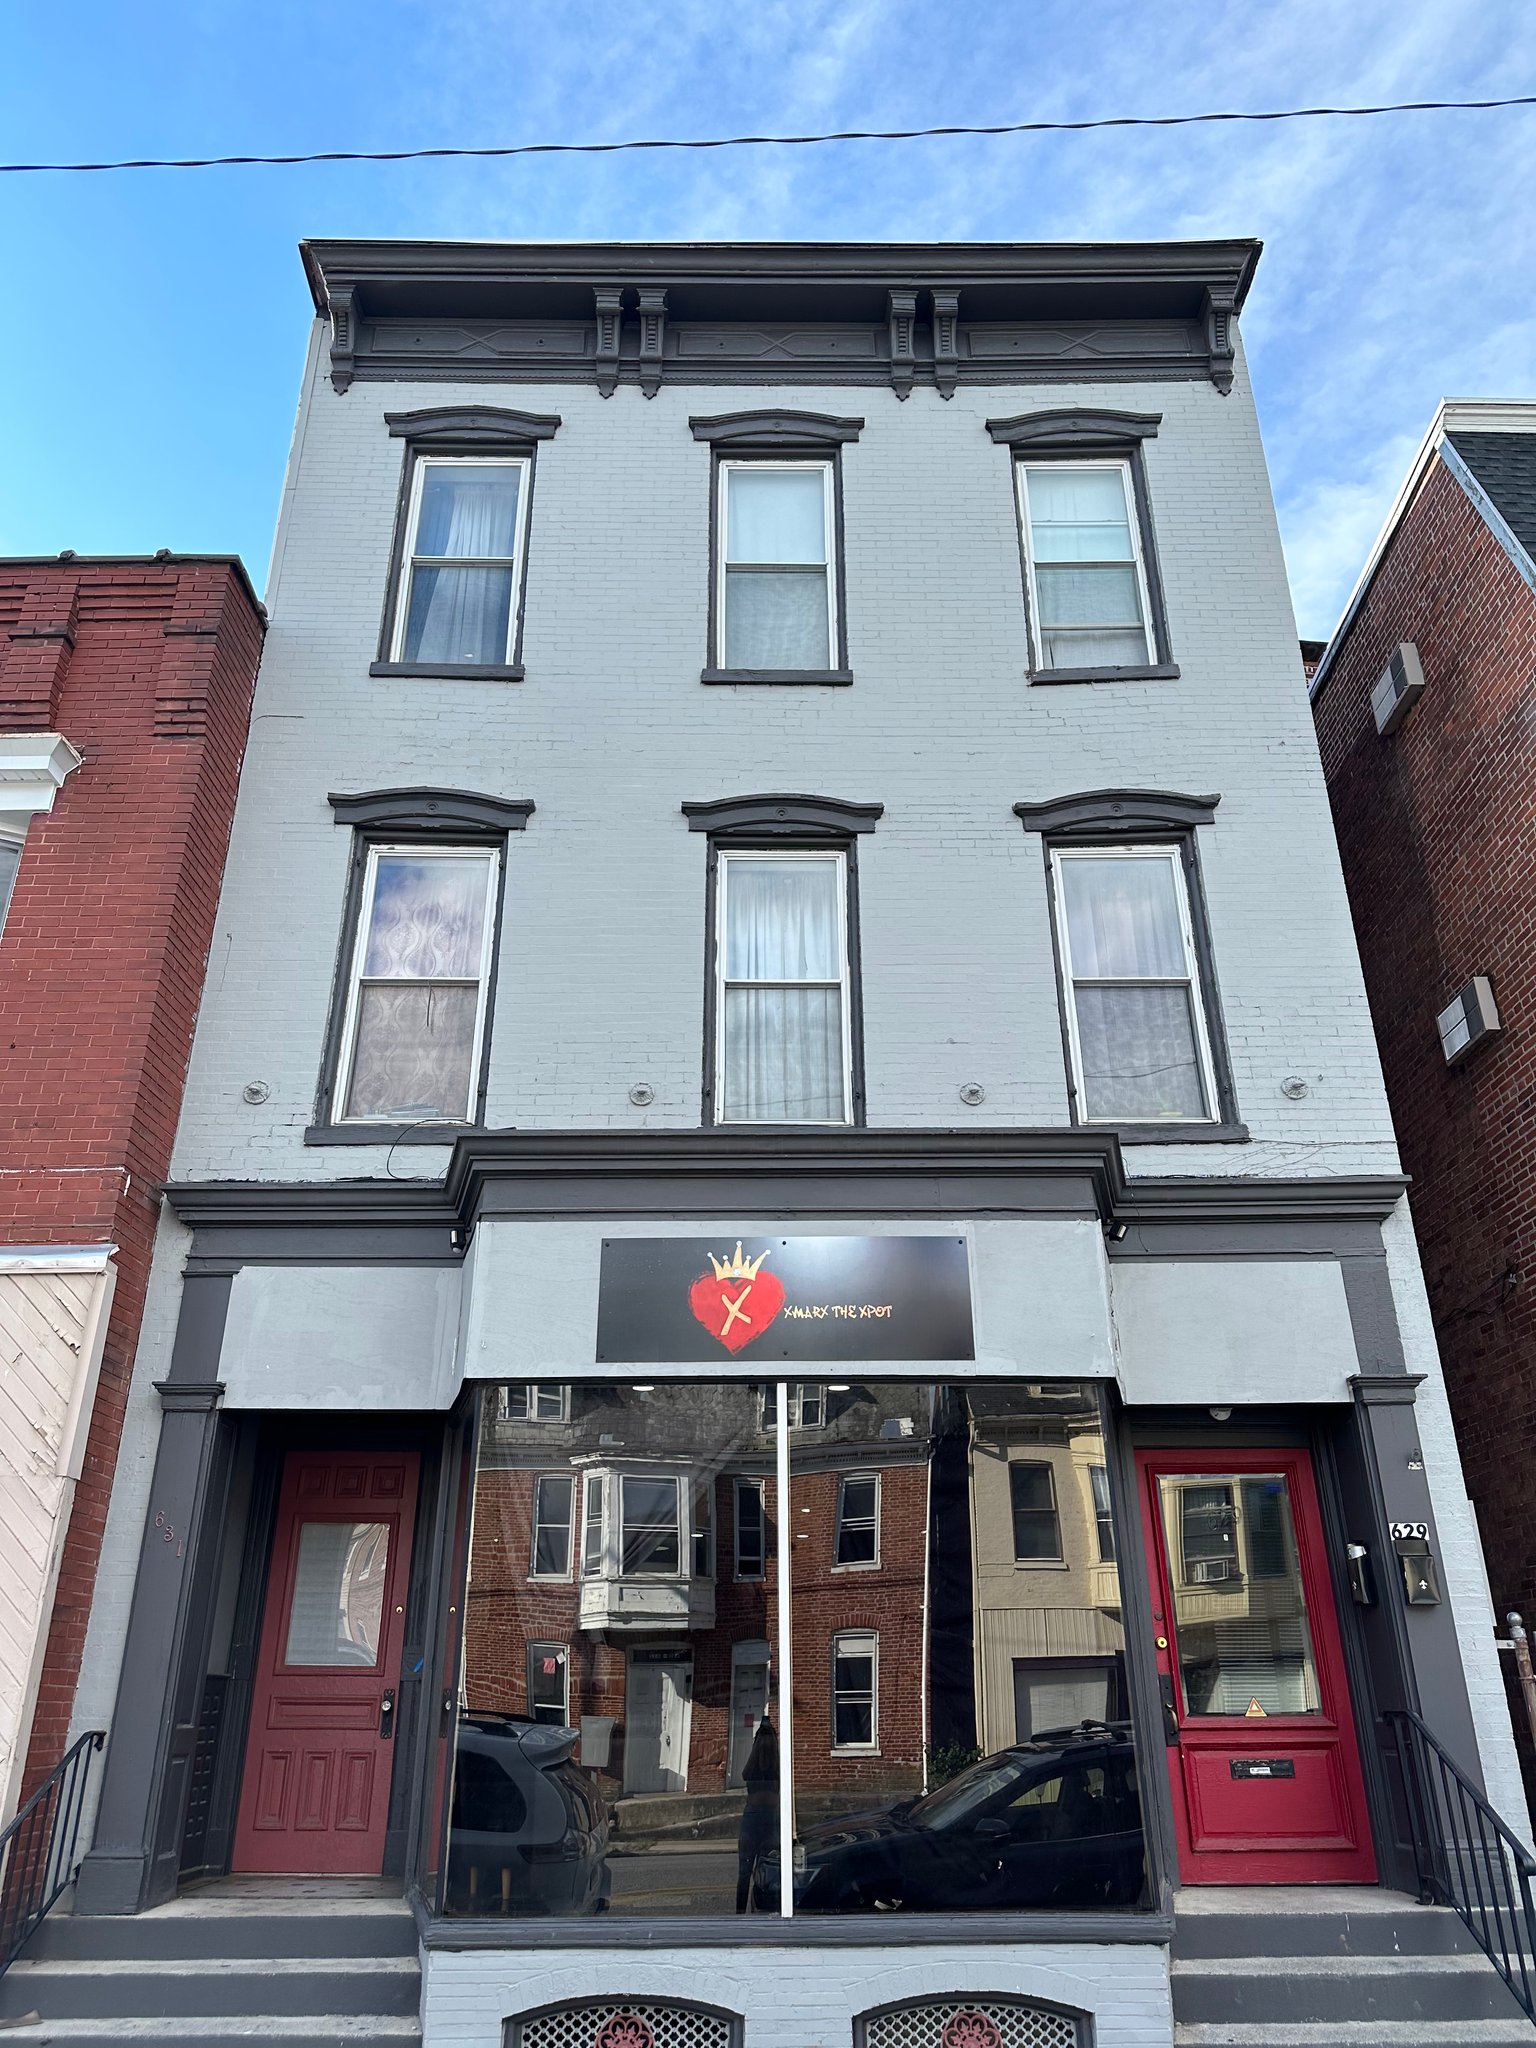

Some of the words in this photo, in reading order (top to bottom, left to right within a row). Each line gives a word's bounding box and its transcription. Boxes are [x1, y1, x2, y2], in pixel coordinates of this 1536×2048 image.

[720, 1284, 752, 1336] X
[783, 1305, 829, 1319] XMARX
[831, 1305, 857, 1319] THE
[858, 1305, 893, 1319] XPOT
[155, 1510, 183, 1557] 631
[1391, 1523, 1427, 1540] 629
